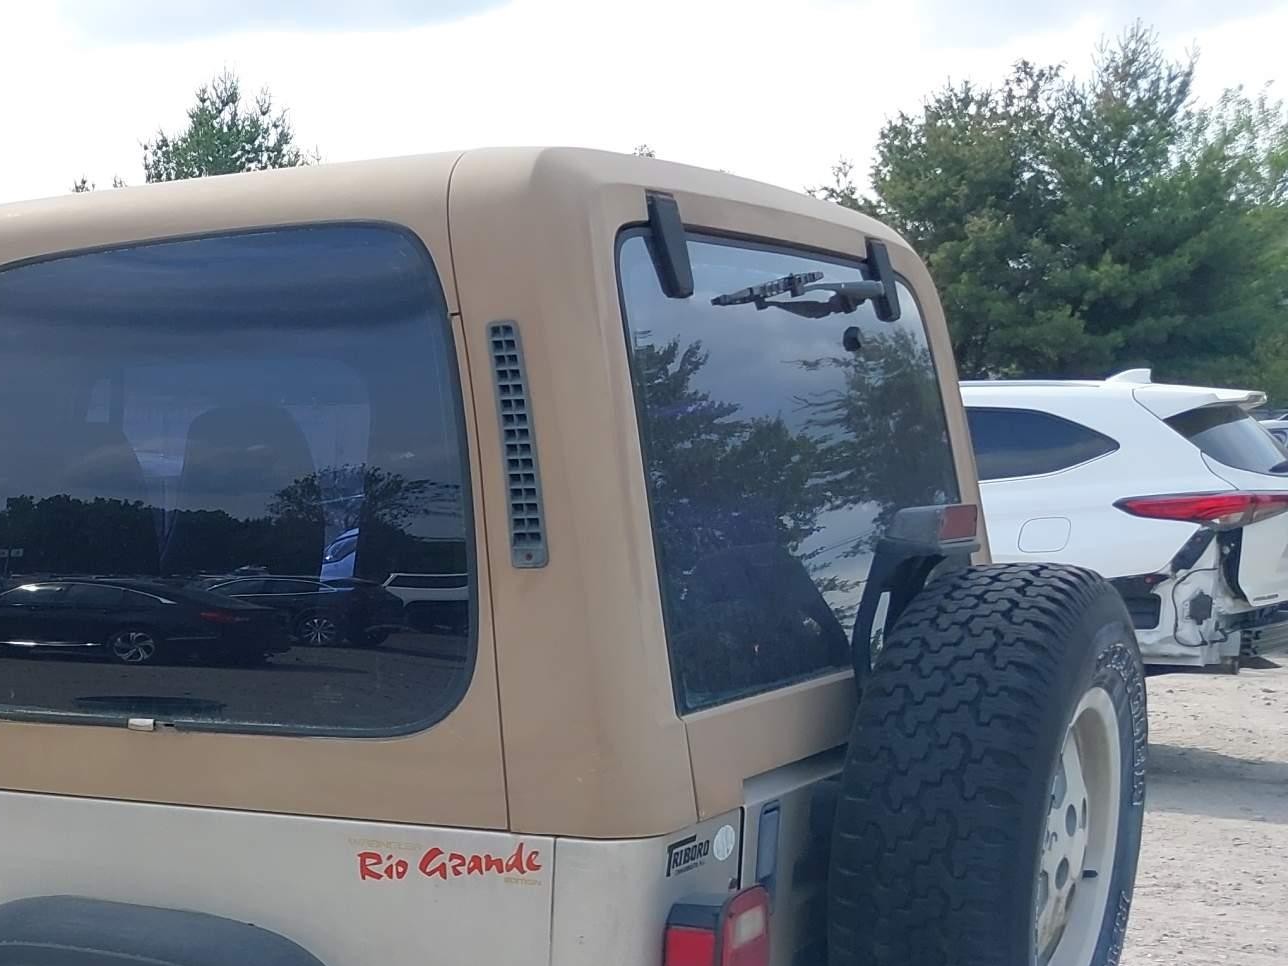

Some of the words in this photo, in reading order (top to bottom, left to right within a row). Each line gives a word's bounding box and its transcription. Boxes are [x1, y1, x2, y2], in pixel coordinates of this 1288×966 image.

[357, 851, 409, 881] Rio
[418, 842, 543, 881] Grande
[666, 834, 710, 877] TRIBORO
